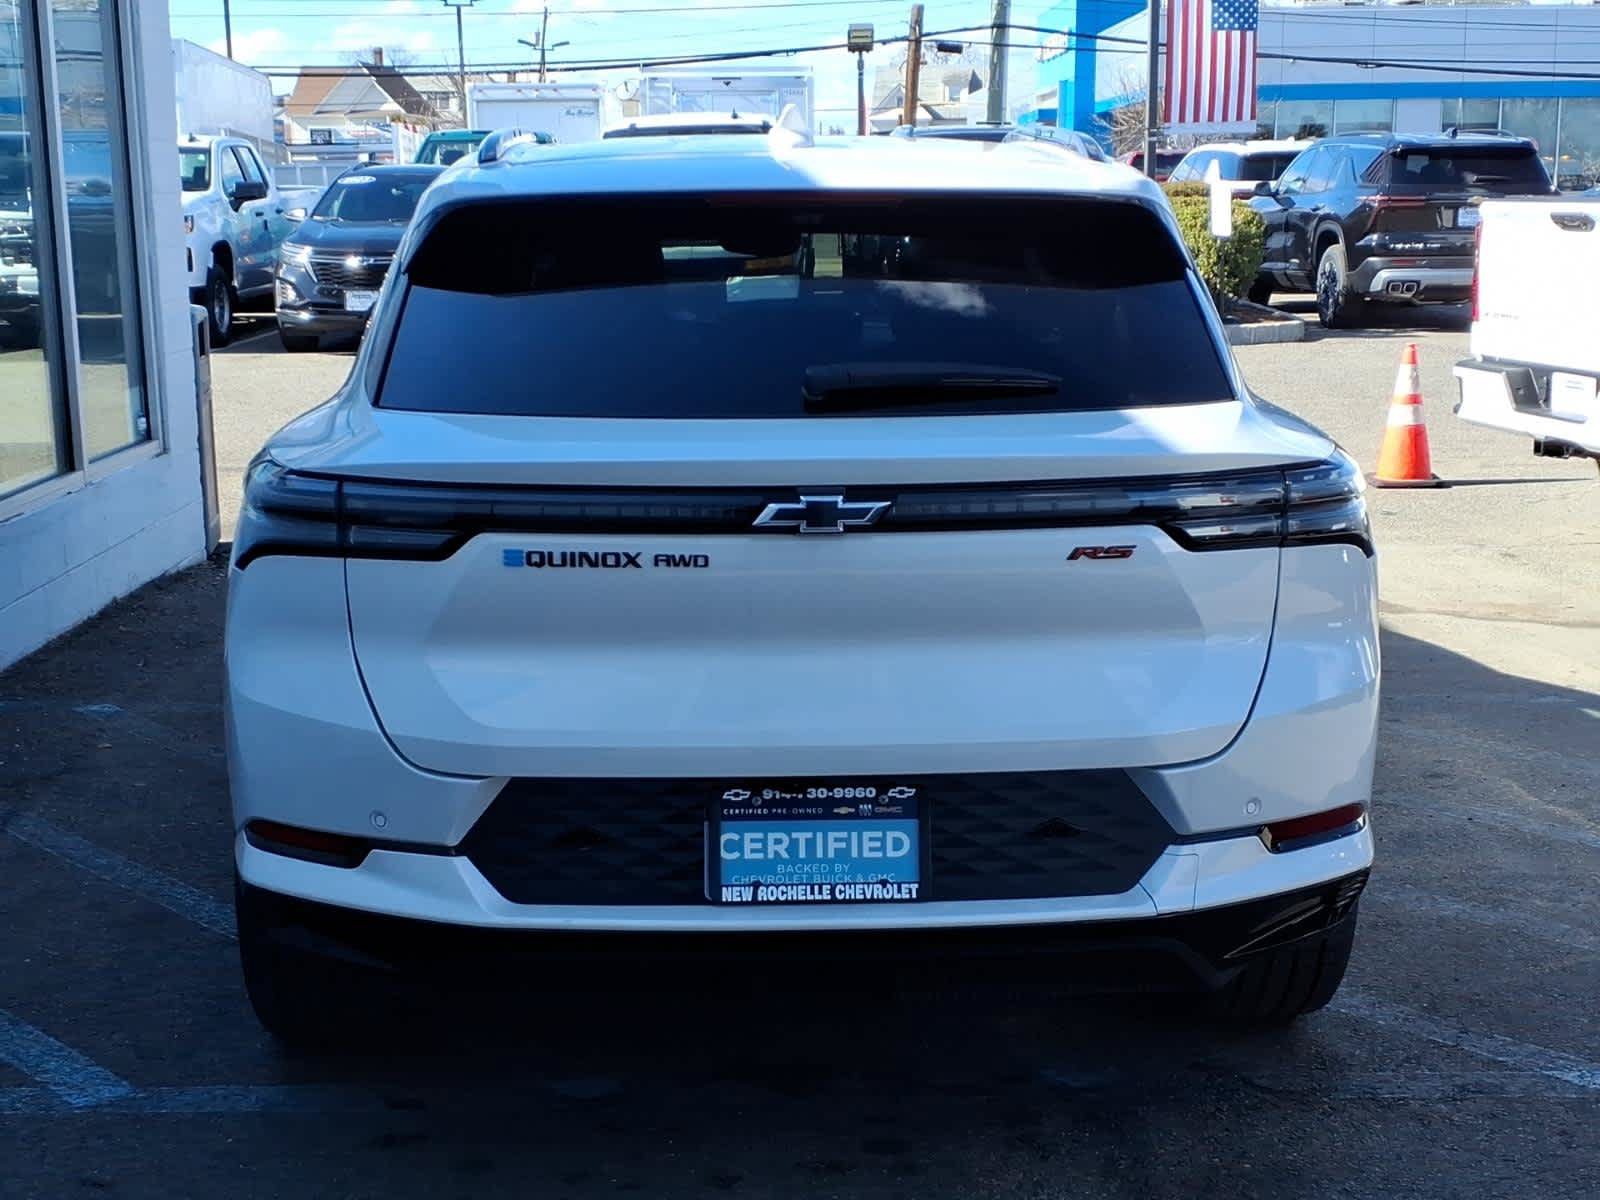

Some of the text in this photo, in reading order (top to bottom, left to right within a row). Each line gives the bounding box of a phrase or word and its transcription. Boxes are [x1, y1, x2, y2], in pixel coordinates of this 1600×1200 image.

[1066, 545, 1137, 560] RS
[653, 553, 709, 568] AWD
[720, 831, 911, 860] CERTIFIED
[777, 863, 850, 873] BACKED BY
[732, 874, 809, 884] CHEVROLET
[813, 873, 852, 884] BUICK
[856, 873, 864, 883] &
[722, 883, 919, 902] NEW ROCHELLE CHEVROLET
